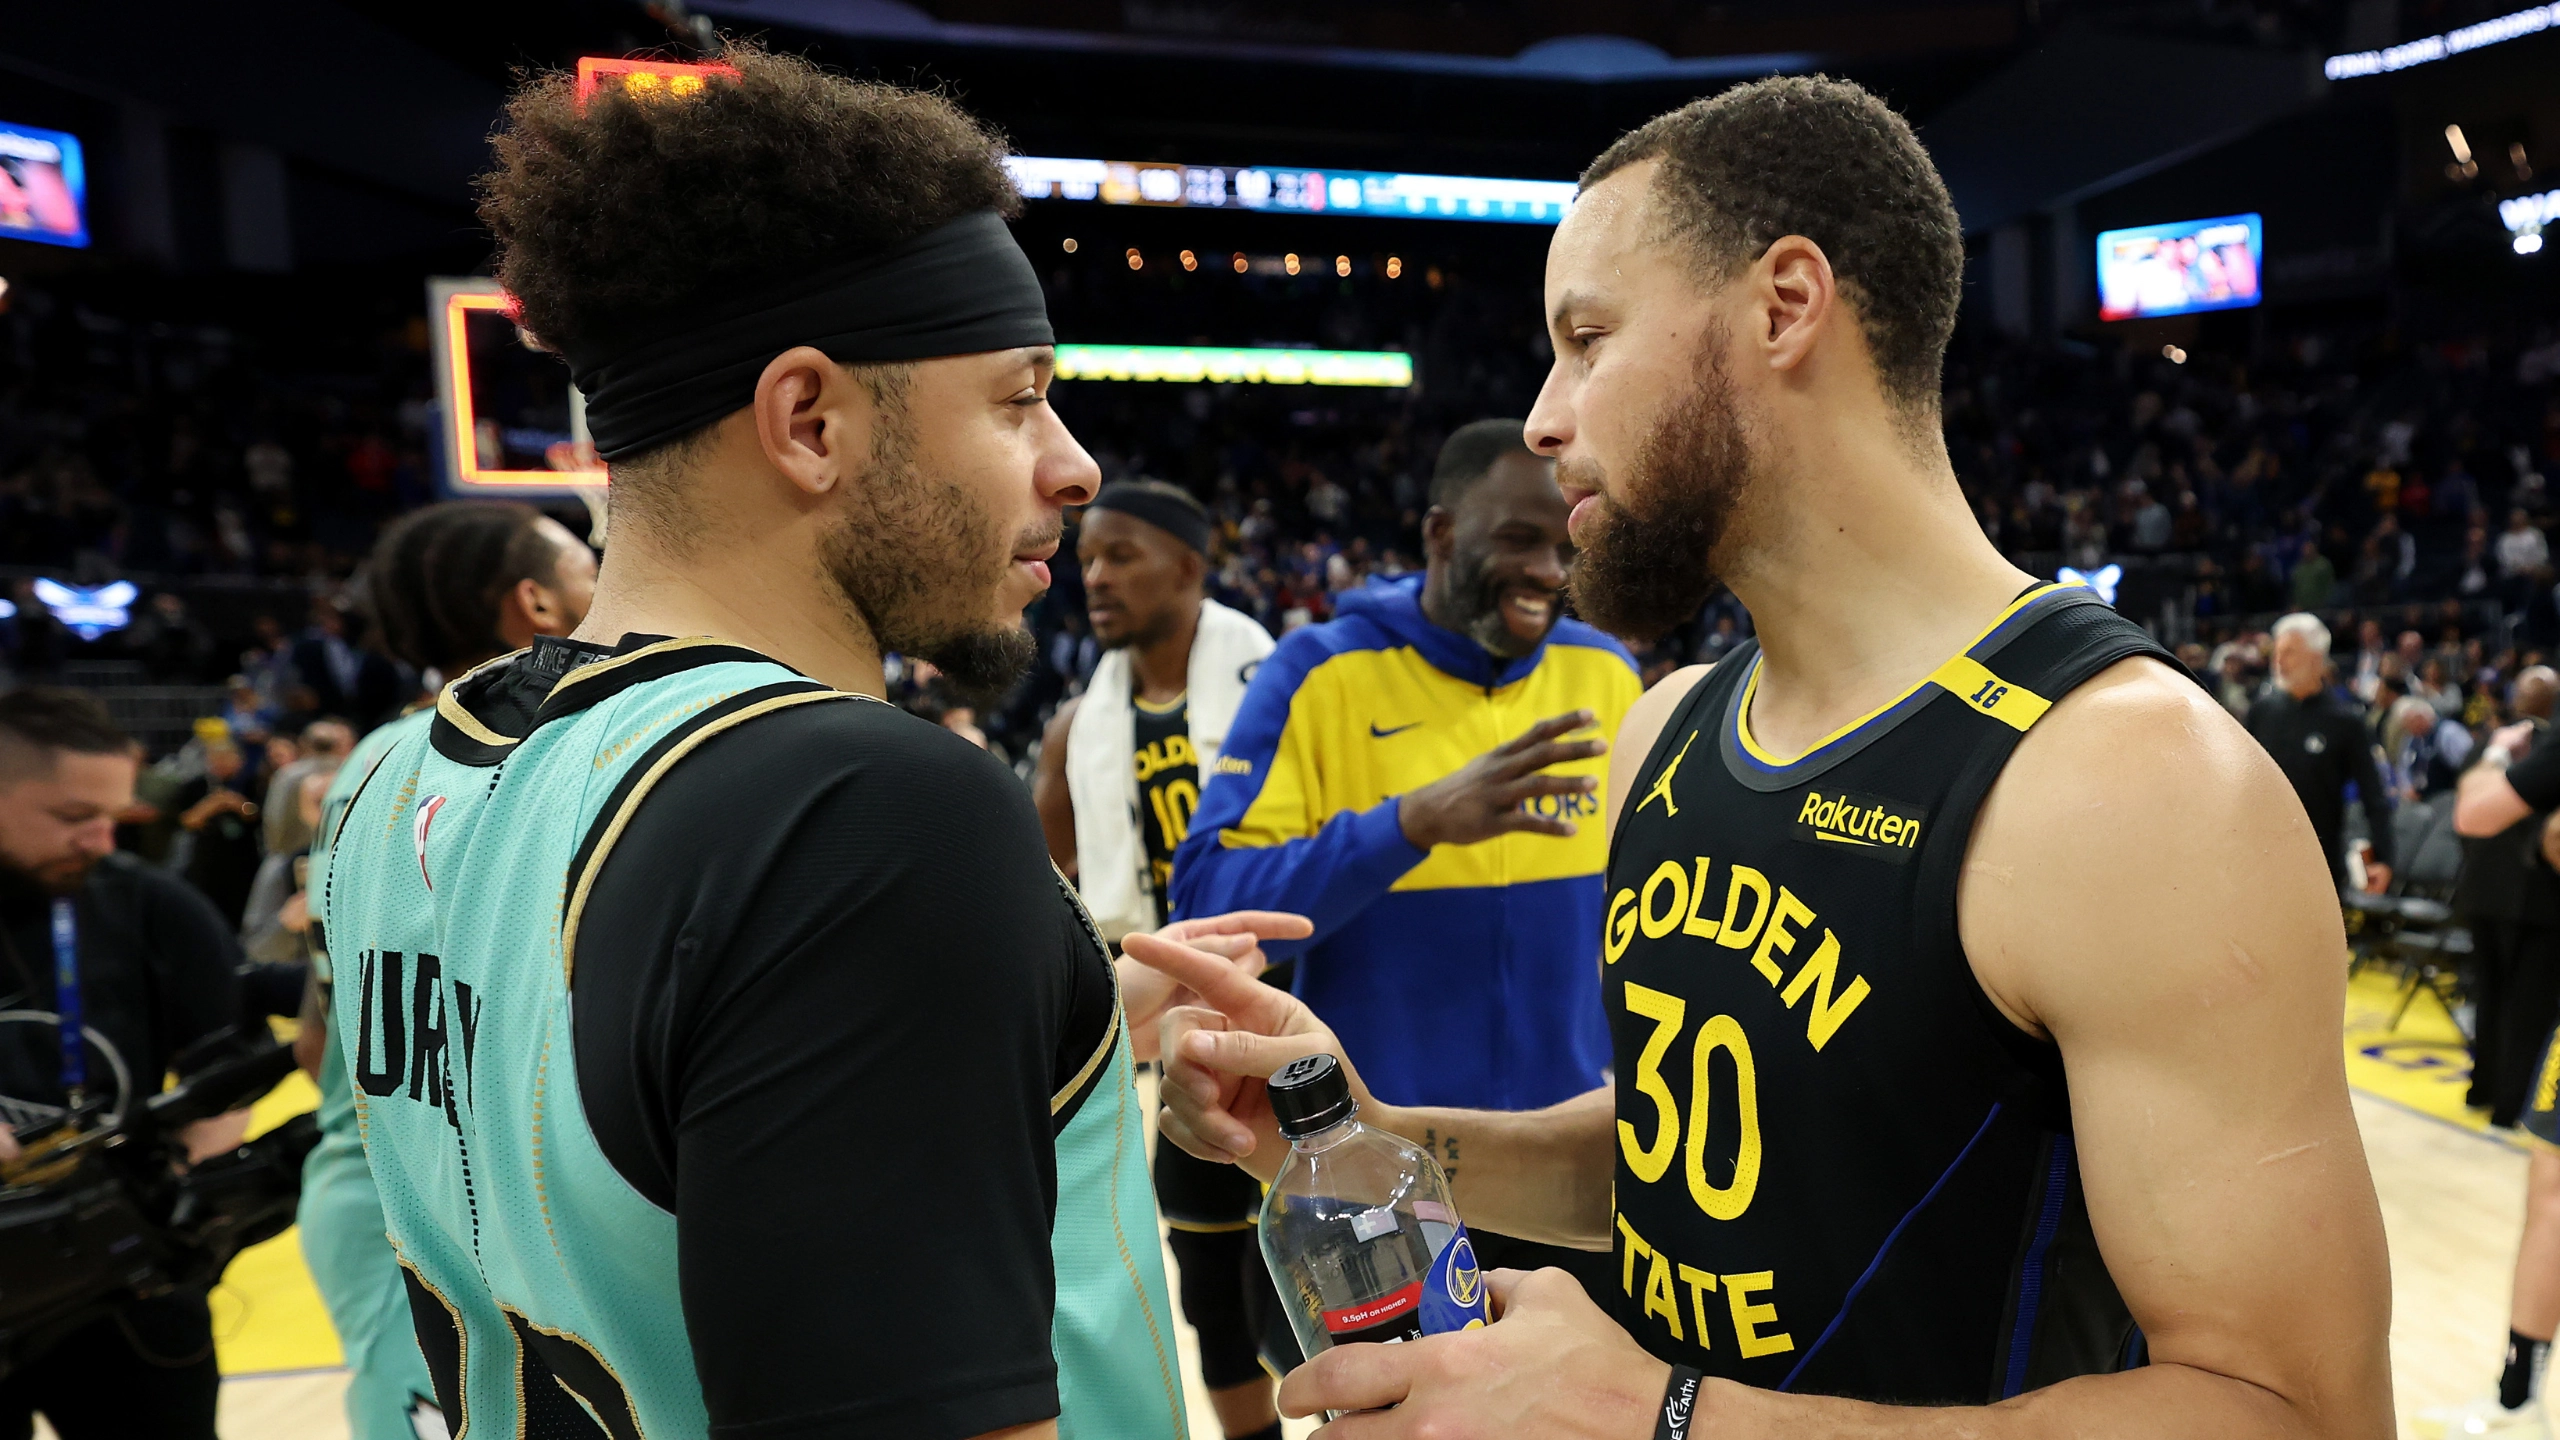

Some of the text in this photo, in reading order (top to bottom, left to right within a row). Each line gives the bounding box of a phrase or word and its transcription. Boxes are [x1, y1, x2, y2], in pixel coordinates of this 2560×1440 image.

[533, 642, 571, 674] NIKE
[1970, 680, 2008, 709] 16
[1134, 734, 1199, 782] OLD
[1150, 778, 1199, 851] 10
[1519, 790, 1599, 821] ORS
[1797, 791, 1920, 849] Rakuten
[1604, 857, 1871, 1052] GOLDEN
[356, 948, 481, 1136] URY
[1617, 980, 1762, 1220] 30
[1341, 1297, 1407, 1324] 9.5pH OR HIGHER
[1614, 1205, 1795, 1359] TATE
